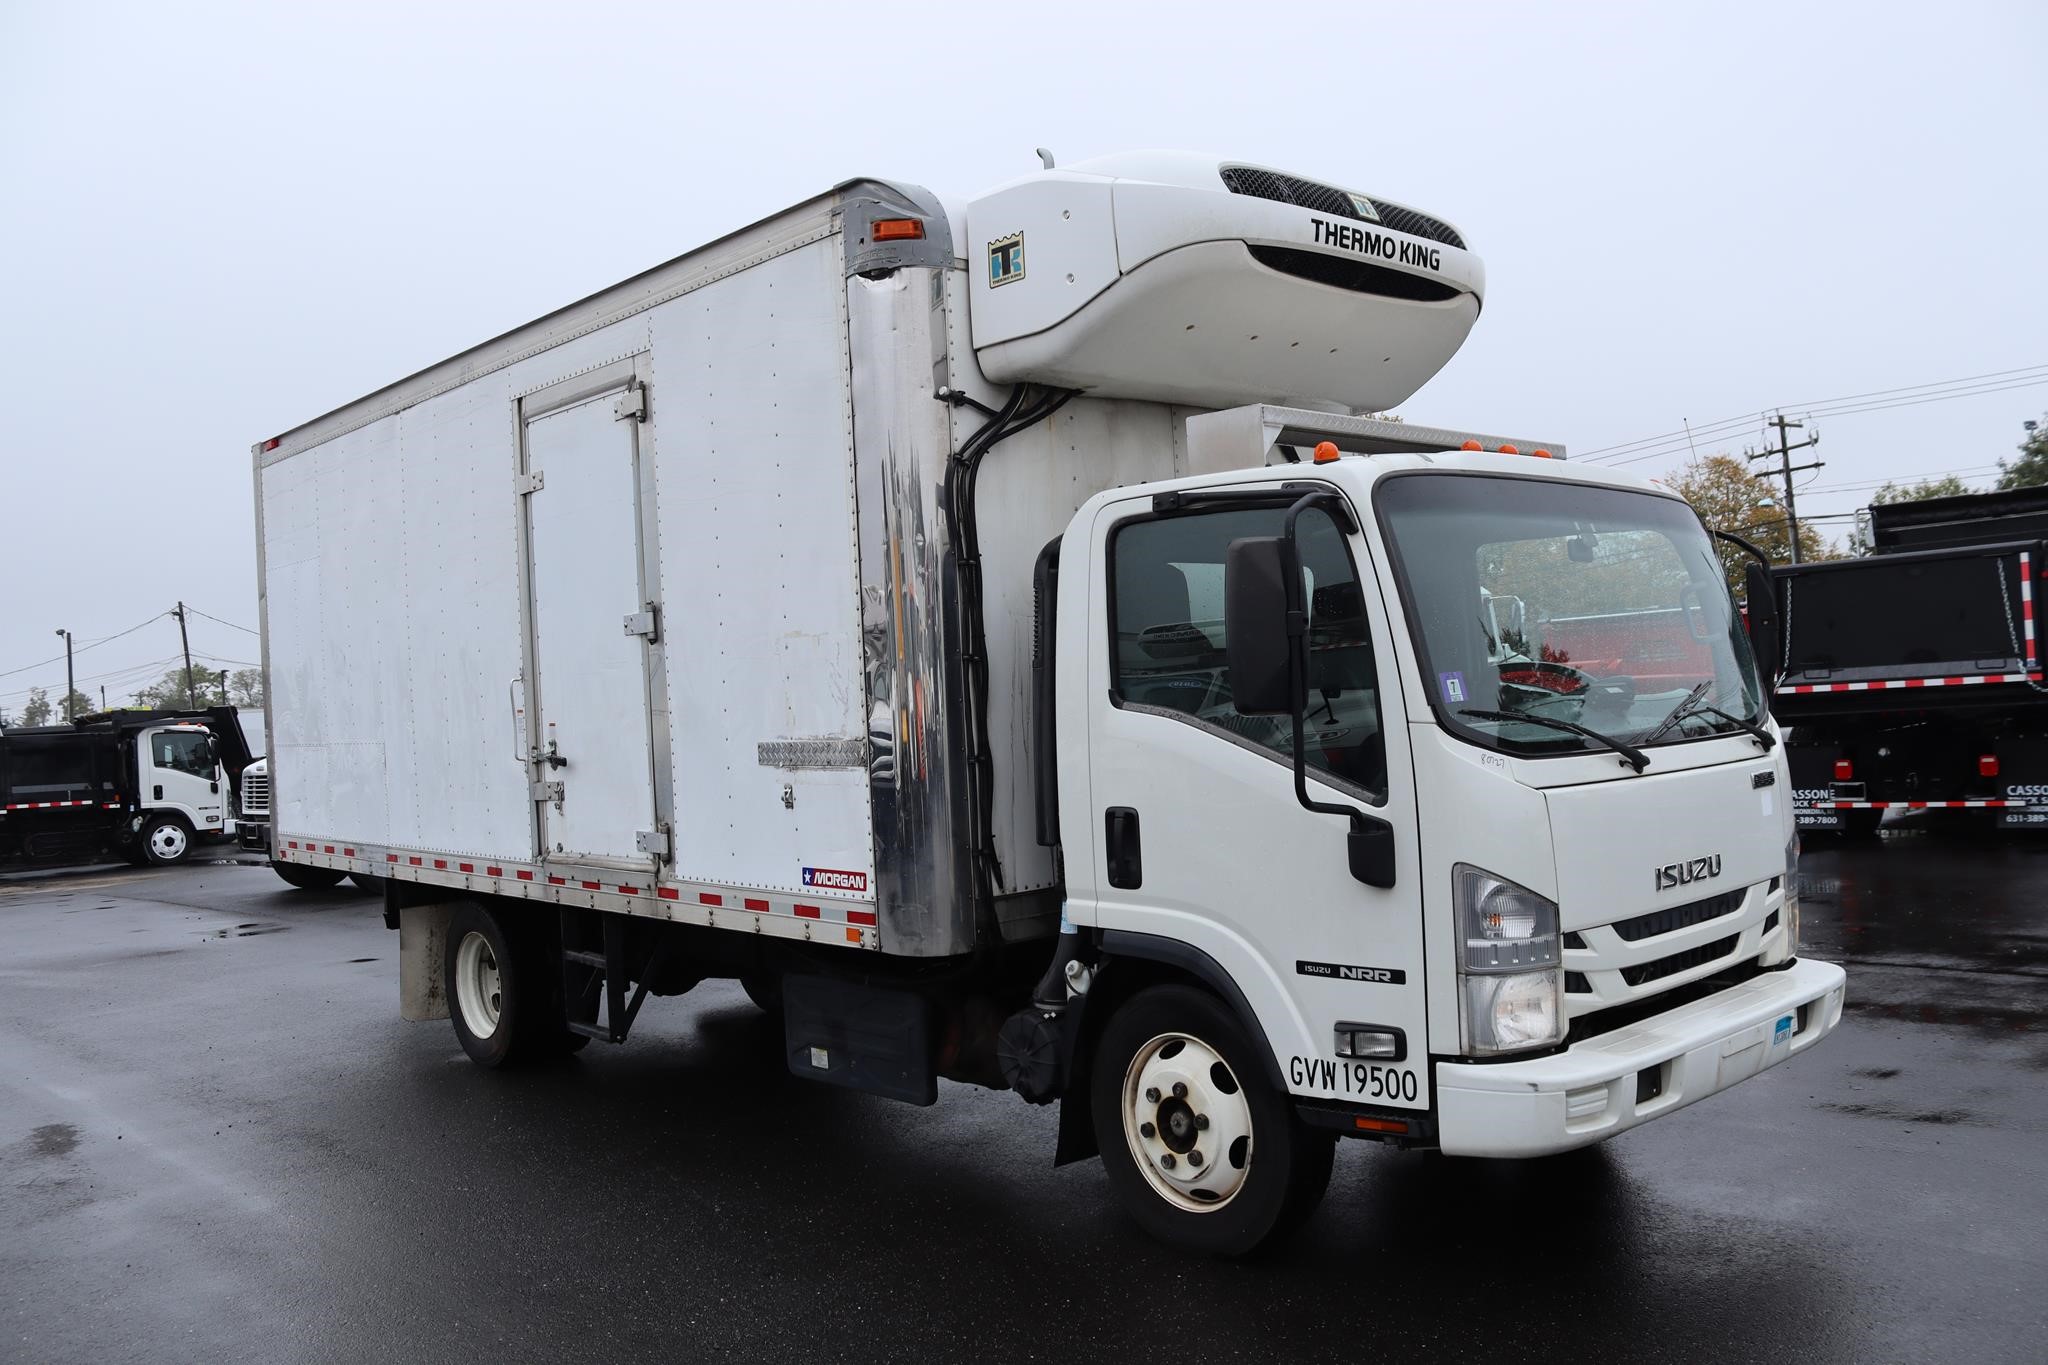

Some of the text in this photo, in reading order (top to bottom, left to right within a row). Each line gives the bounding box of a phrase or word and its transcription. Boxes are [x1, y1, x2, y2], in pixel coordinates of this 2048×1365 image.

[1311, 218, 1440, 271] THERMO KING
[1792, 789, 1836, 800] ASSONE
[2007, 785, 2048, 796] CASSO
[1796, 816, 1838, 824] -389-7800
[2006, 814, 2048, 823] 631-389-
[813, 871, 865, 890] MORGAN
[1655, 853, 1722, 892] ISUZU
[1304, 964, 1392, 982] ISUZU NRR
[1290, 1055, 1418, 1102] GVW 19500
